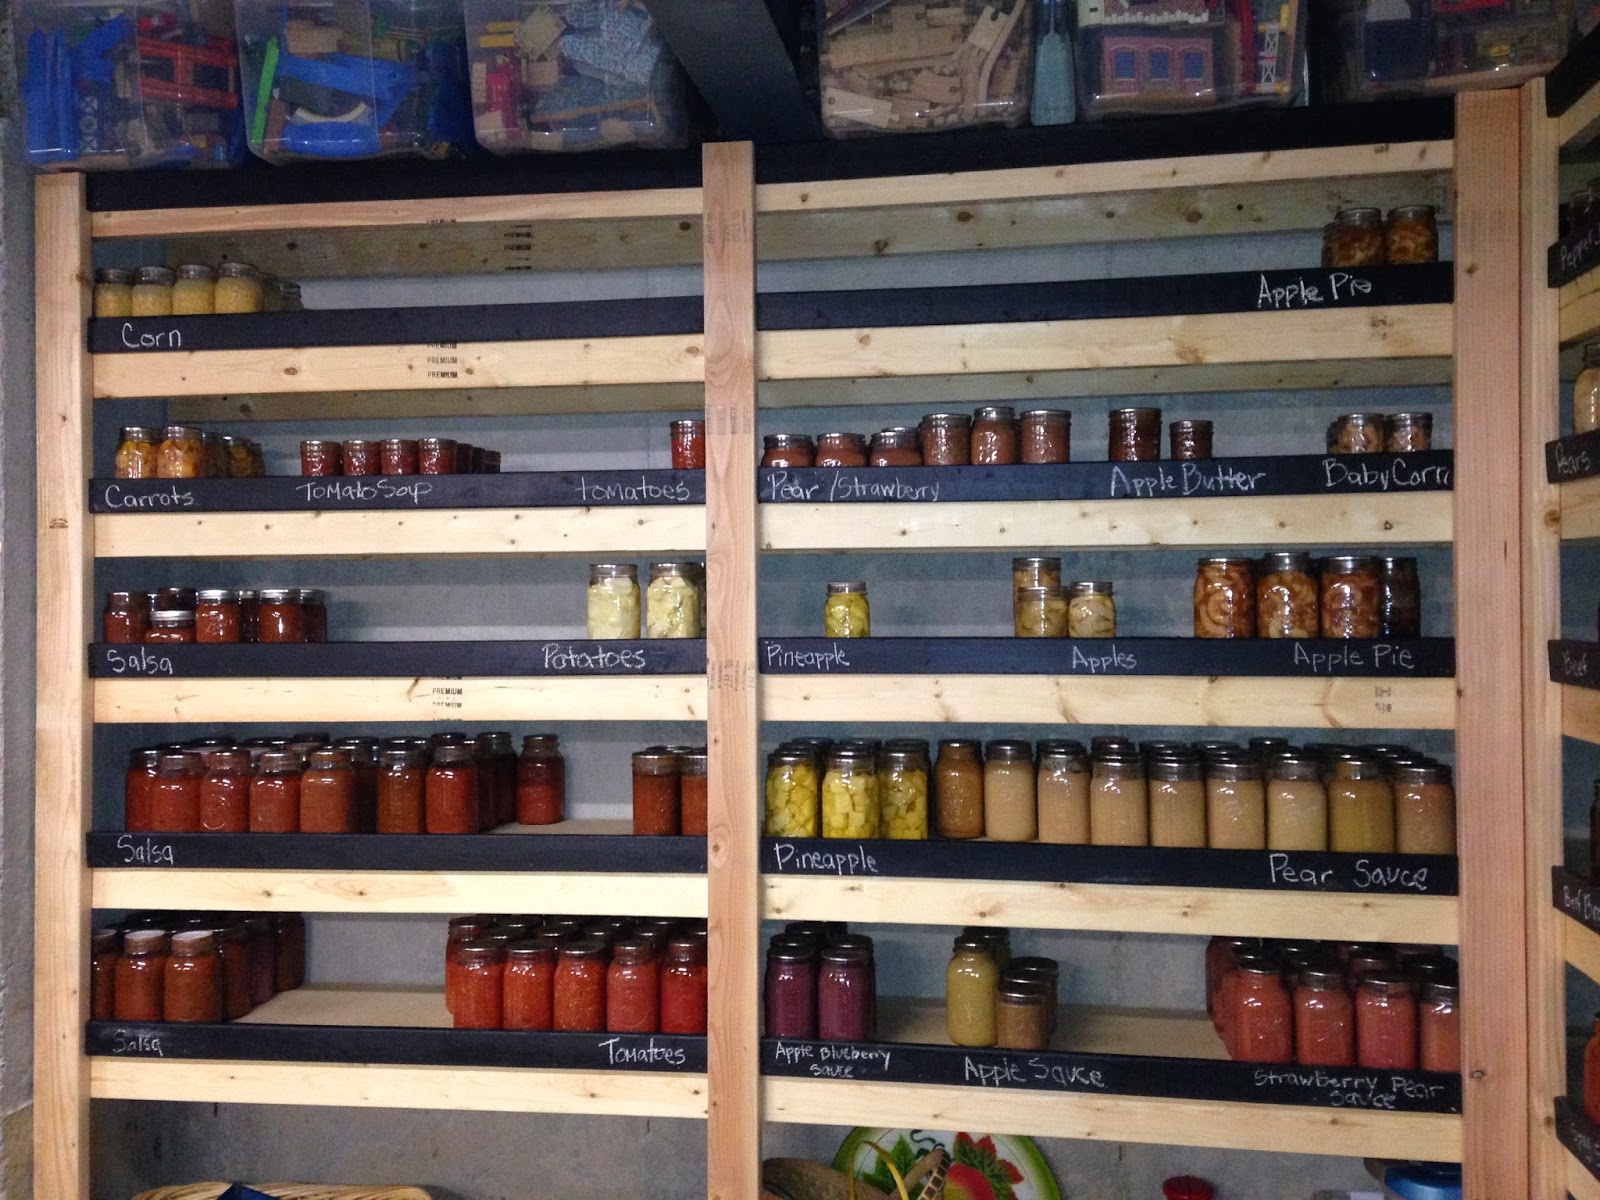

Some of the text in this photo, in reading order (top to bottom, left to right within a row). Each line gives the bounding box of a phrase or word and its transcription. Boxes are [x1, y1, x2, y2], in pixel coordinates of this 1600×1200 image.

[1257, 272, 1372, 308] Apple Pie
[121, 322, 182, 348] Corn
[427, 356, 458, 364] PREMIUM
[427, 371, 458, 379] PREMIUM
[766, 471, 820, 501] Pear
[1110, 462, 1267, 497] Apple Butter
[104, 484, 195, 508] Carrots
[106, 646, 173, 675] Salsa
[541, 642, 647, 670] Potatoes
[763, 641, 851, 671] Pineapple
[1072, 643, 1138, 674] Apples
[1293, 641, 1415, 673] Apple Pie
[432, 687, 463, 695] PREMIUM
[116, 834, 174, 866] Salsa
[773, 842, 880, 876] Pineapple
[1269, 852, 1428, 891] Pear Sauce
[112, 1028, 164, 1057] Salsa
[597, 1037, 687, 1066] Tomatoes
[775, 1041, 892, 1072] Apple Blueberry
[965, 1055, 1106, 1088] Apple Sauce
[1254, 1069, 1446, 1100] Strawberry Pear
